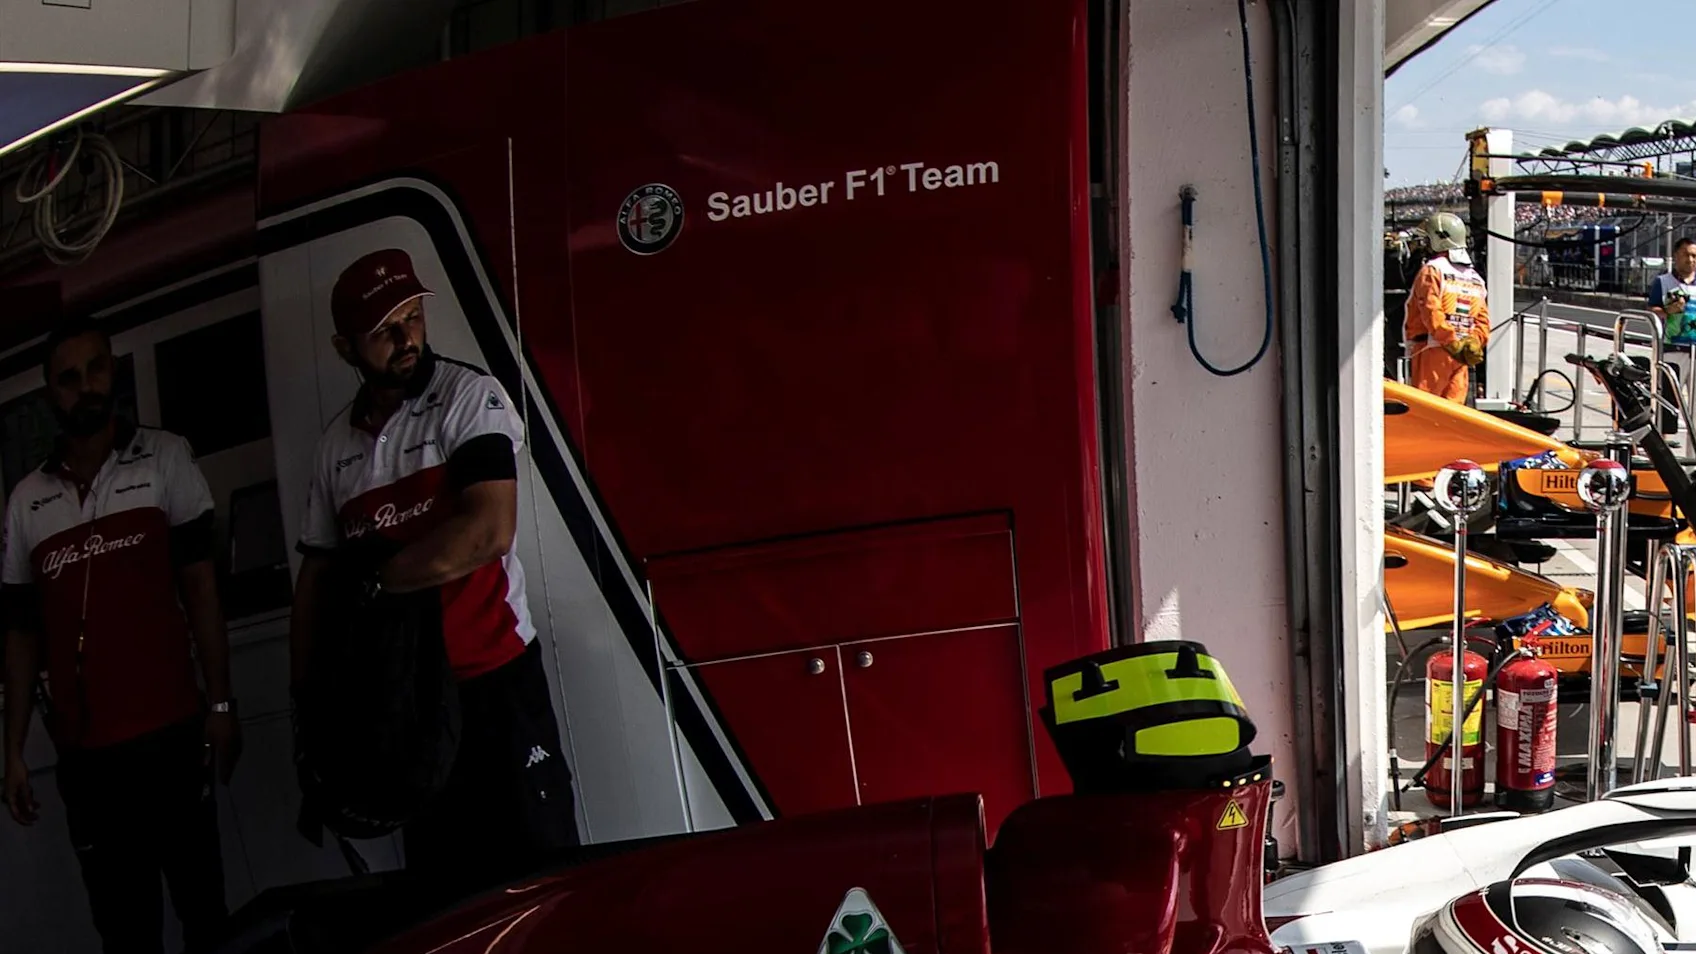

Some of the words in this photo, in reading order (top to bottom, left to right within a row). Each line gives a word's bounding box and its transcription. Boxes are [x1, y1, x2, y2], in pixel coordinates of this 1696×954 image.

[706, 180, 835, 222] Sauber
[900, 158, 1000, 192] Team
[1546, 475, 1578, 489] Hilt
[373, 495, 436, 529] Romeo
[42, 544, 80, 580] Alfa
[83, 531, 148, 559] Romeo
